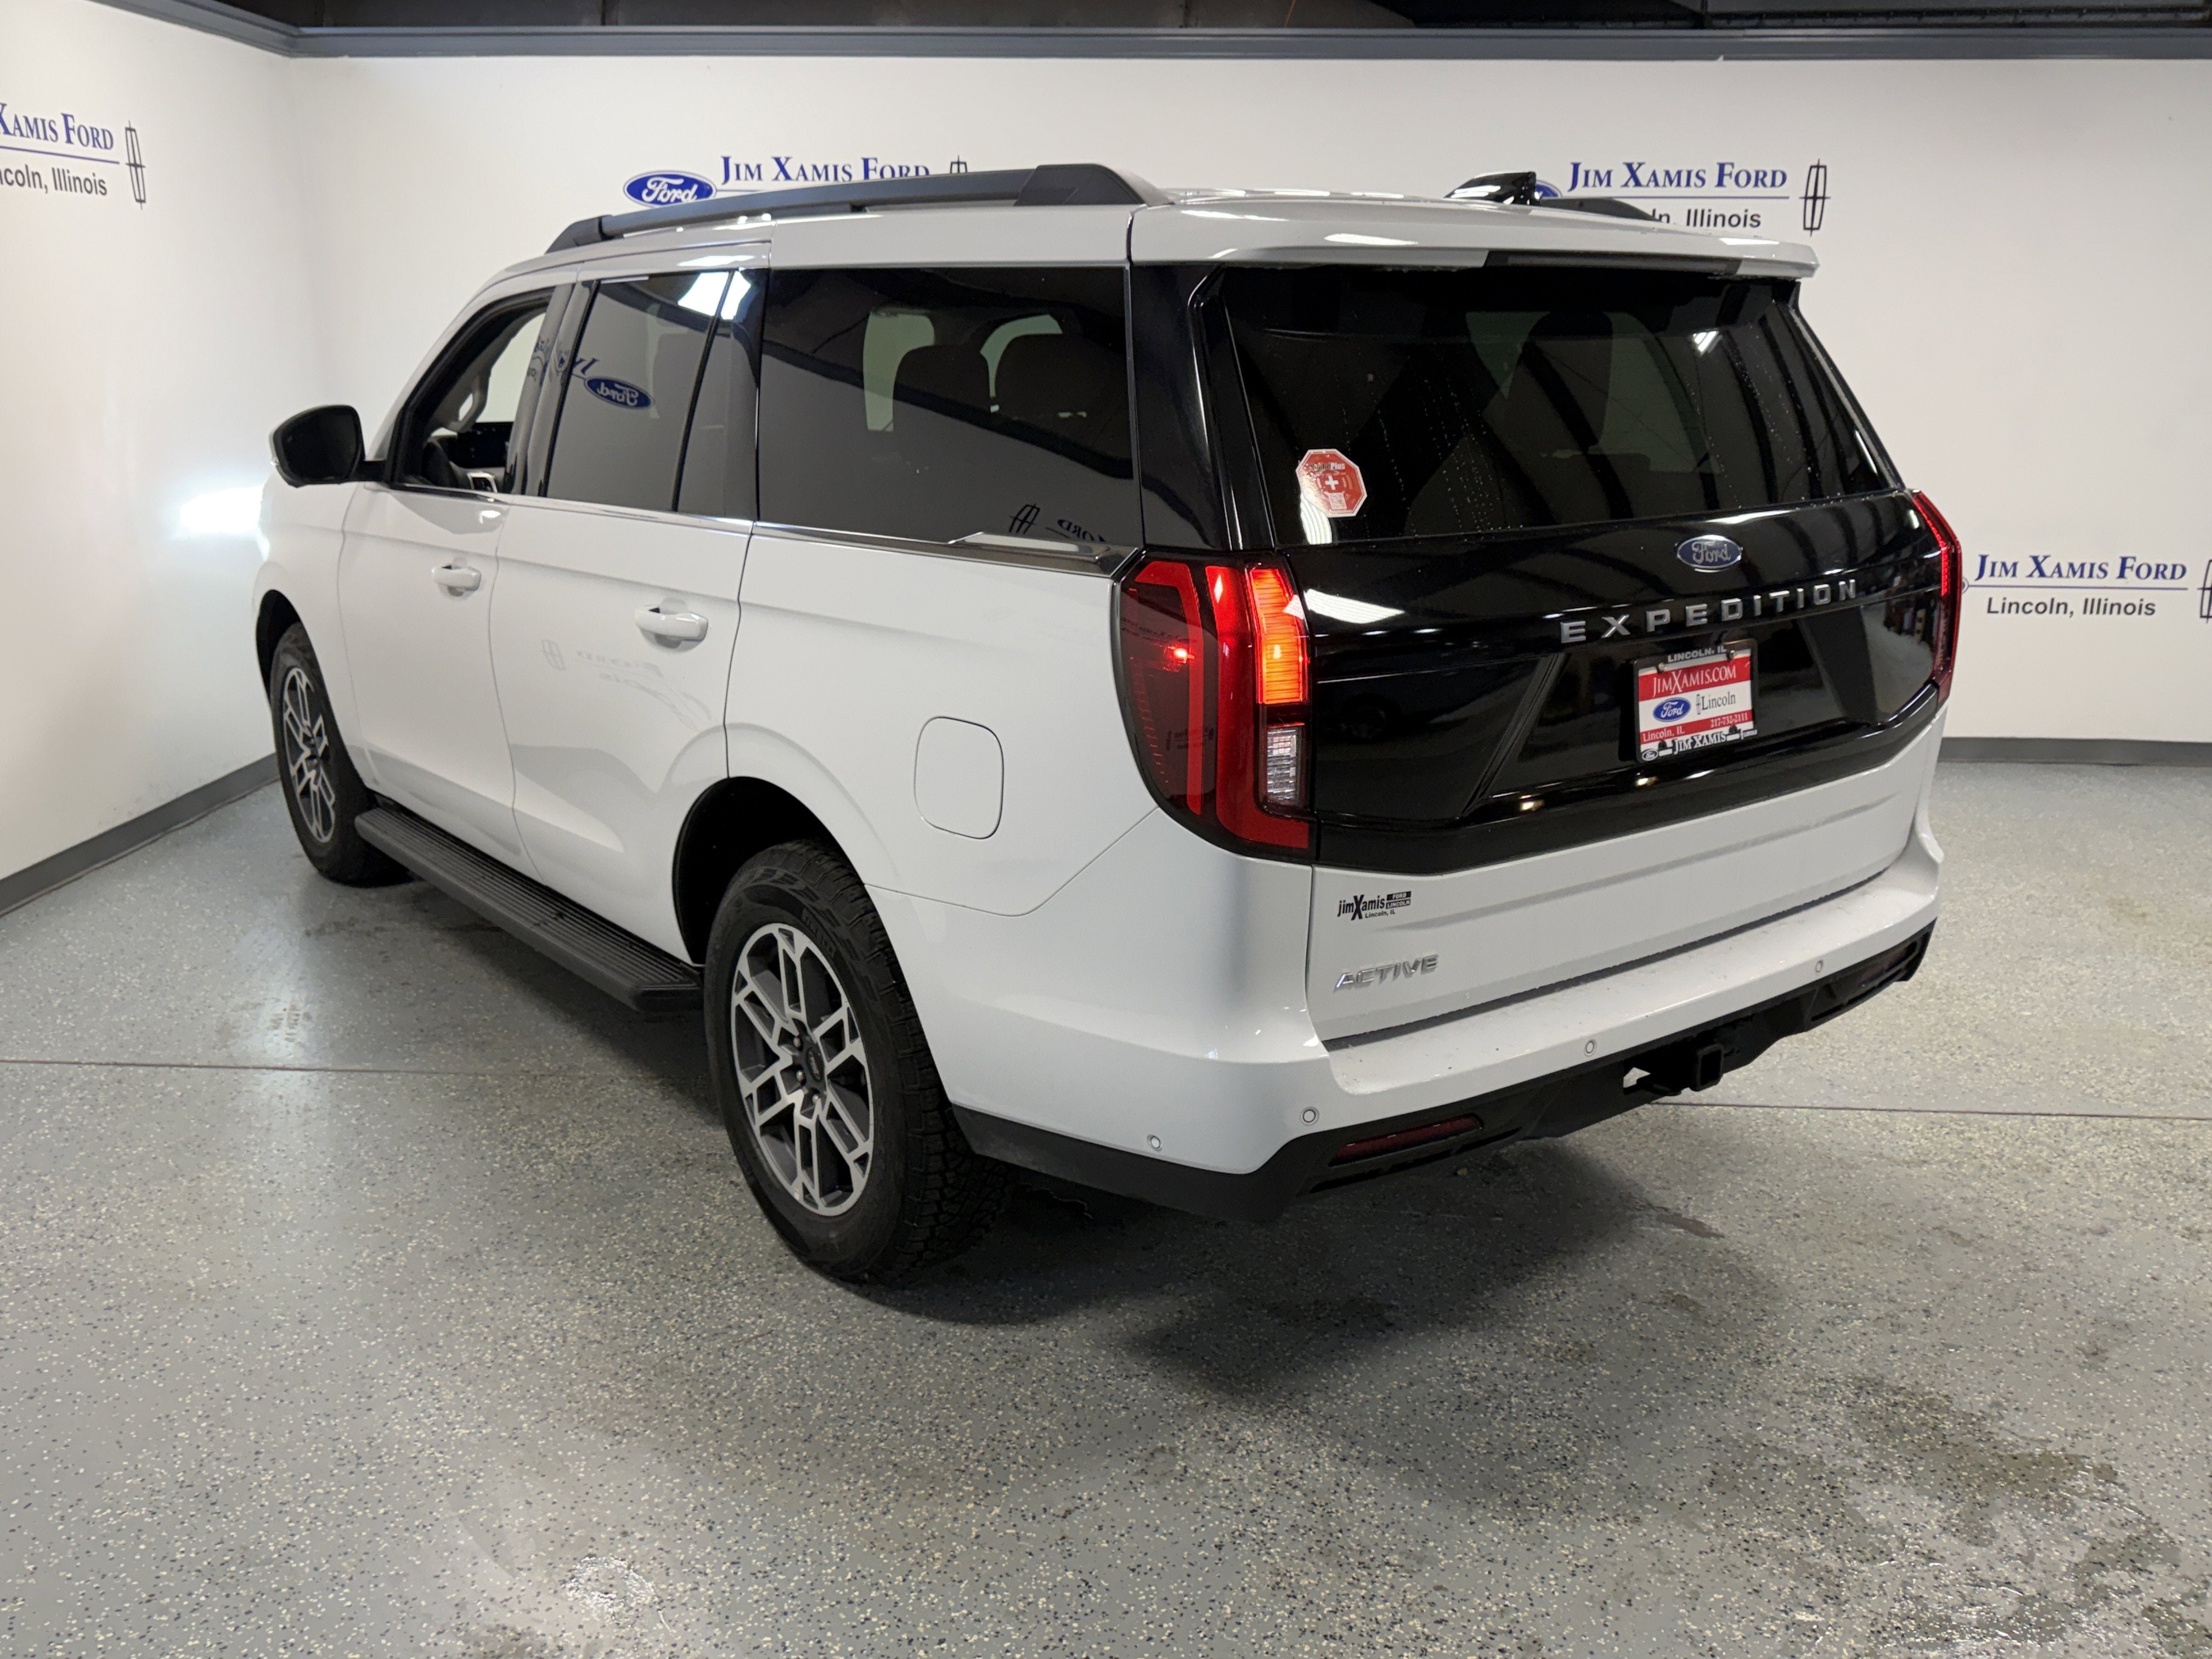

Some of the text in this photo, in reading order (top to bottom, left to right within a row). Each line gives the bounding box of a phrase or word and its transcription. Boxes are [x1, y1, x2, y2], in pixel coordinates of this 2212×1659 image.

[0, 164, 108, 196] coln, Illinois
[641, 176, 698, 203] Ford
[1686, 208, 1761, 228] Illinois
[1560, 579, 1857, 644] EXPEDITION
[1987, 597, 2156, 618] Lincoln, Illinois
[1717, 646, 1727, 654] IL
[1701, 692, 1736, 711] Lincoln
[1677, 725, 1685, 736] IL
[1711, 713, 1748, 728] 217-732-2111
[1674, 739, 1692, 754] JIM
[1694, 732, 1726, 748] XAMIS
[1365, 910, 1389, 918] Lincoln,
[1334, 954, 1438, 992] ACTIVE
